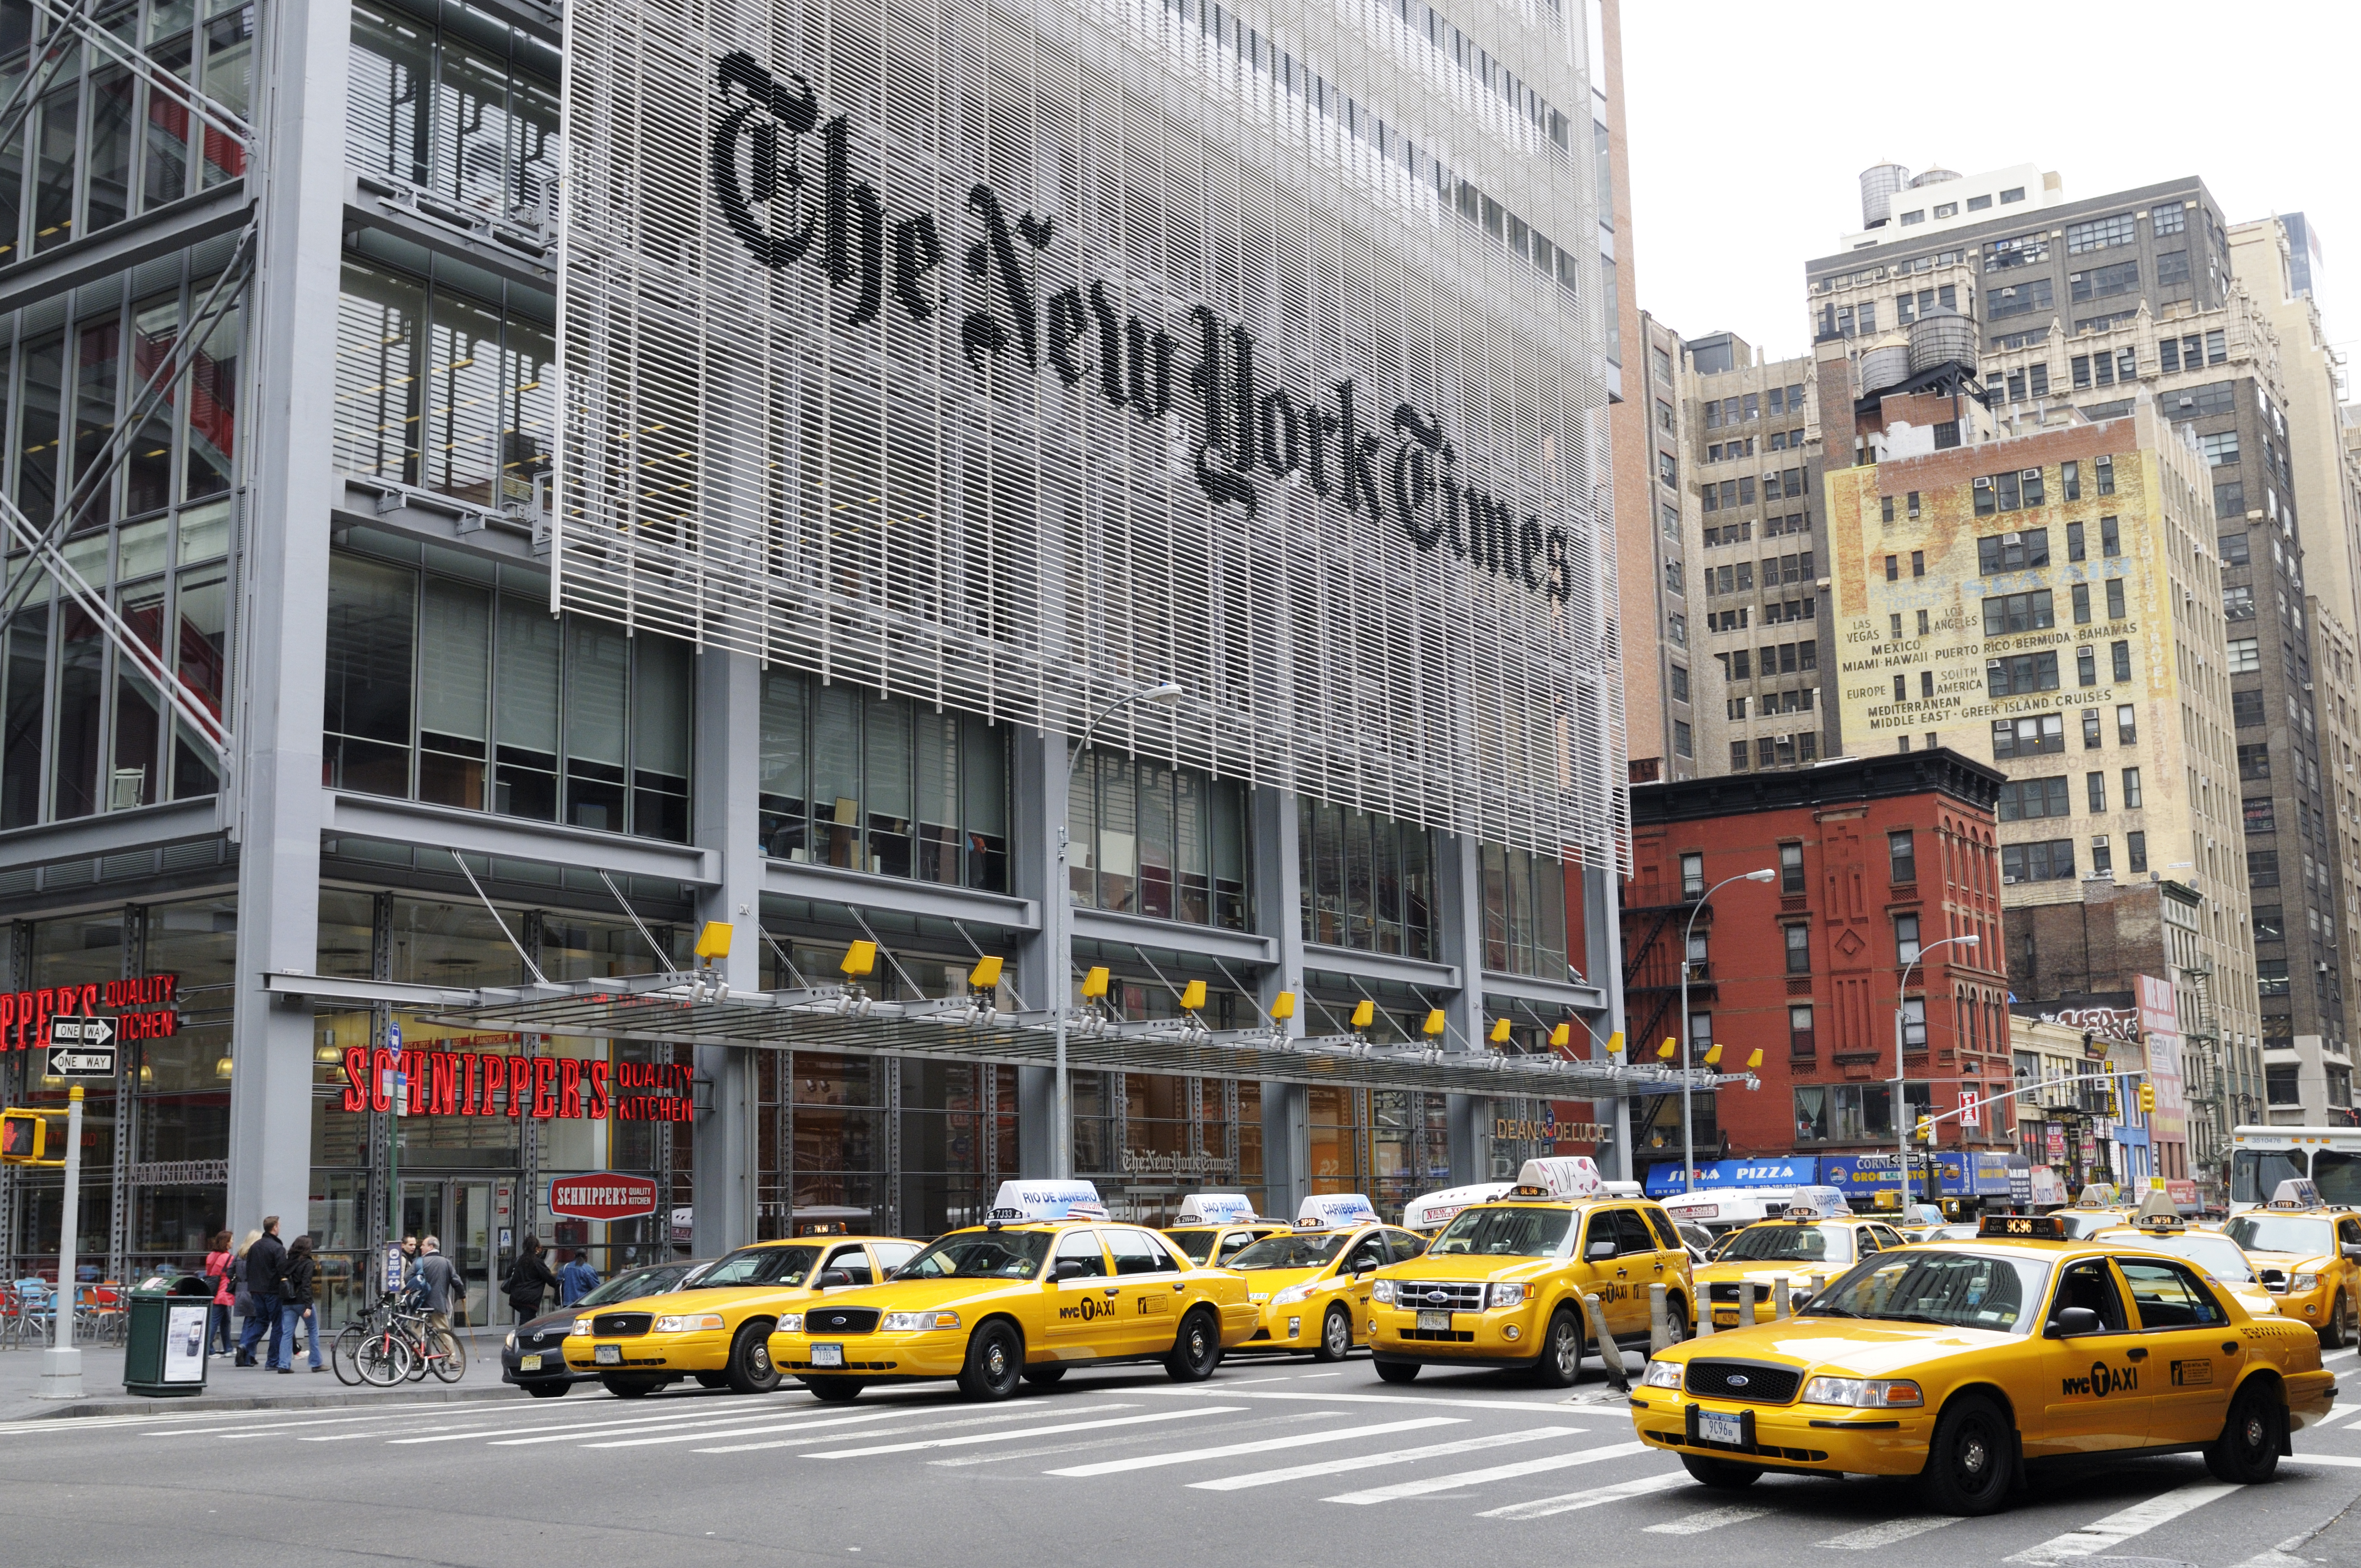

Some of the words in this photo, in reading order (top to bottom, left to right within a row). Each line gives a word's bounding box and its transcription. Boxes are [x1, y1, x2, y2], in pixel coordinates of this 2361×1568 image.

[712, 50, 946, 328] The
[961, 183, 1179, 421] New
[1190, 304, 1381, 520] York
[1392, 402, 1573, 605] Times
[1945, 606, 1964, 617] LOS
[1853, 619, 1871, 630] LAS
[1934, 616, 1978, 631] ANGELES
[1847, 630, 1879, 643] VEGAS
[1843, 658, 1879, 672] MIAMI
[1885, 652, 1927, 666] HAWAII
[1935, 645, 1978, 660] PUERTO
[1984, 640, 2010, 653] RICO
[2016, 633, 2071, 649] BERMUDA
[2079, 623, 2137, 640] BAHAMAS
[1872, 640, 1921, 655] MEXICO
[2148, 620, 2164, 688] TRAVEL
[1941, 667, 1977, 680] SOUTH
[1847, 685, 1886, 700] EUROPE
[1936, 679, 1983, 695] AMERICA
[1868, 696, 1961, 717] MEDITERRANEAN
[1870, 715, 1914, 729] MIDDLE
[1921, 710, 1951, 723] EAST
[1961, 705, 1999, 718] GREEK
[2005, 698, 2049, 713] ISLAND
[2055, 689, 2112, 706] CRUISES
[106, 974, 179, 1008] QUALITY
[2142, 975, 2157, 1010] WE
[2156, 978, 2172, 1012] BUY
[61, 1025, 79, 1036] ONE
[88, 1027, 107, 1037] WAY
[476, 1035, 506, 1045] SANDWICHES
[2150, 1037, 2168, 1057] GEM
[58, 1056, 77, 1067] ONE
[86, 1057, 107, 1068] WAY
[342, 1046, 610, 1120] SCHNIPPER'S
[617, 1061, 694, 1090] QUALITY
[616, 1095, 694, 1123] KITCHEN
[1497, 1119, 1537, 1140] DEAN
[1541, 1121, 1549, 1139] &
[1554, 1121, 1605, 1142] DELUCA
[1122, 1148, 1145, 1173] The
[1145, 1149, 1172, 1172] New
[1171, 1150, 1201, 1178] York
[1201, 1150, 1233, 1172] Times
[1736, 1166, 1794, 1179] PIZZA
[557, 1186, 627, 1206] SCHNIPPER'S
[629, 1186, 651, 1196] QUALITY
[1022, 1192, 1041, 1204] RIO
[1042, 1192, 1057, 1202] DE
[1058, 1191, 1097, 1202] JANEIRO
[1520, 1187, 1538, 1195] 8L96
[2037, 1188, 2052, 1202] SUITS
[629, 1196, 651, 1205] KITCHEN
[1074, 1201, 1101, 1210] American
[1220, 1202, 1245, 1212] PAULO
[996, 1210, 1012, 1219] 7J33
[1322, 1202, 1369, 1216] CARIBBEAN
[1427, 1203, 1446, 1220] NEW
[1301, 1218, 1315, 1227] 3P56
[2007, 1219, 2032, 1233] 9C96
[2151, 1216, 2171, 1224] 3V51
[502, 1231, 509, 1242] A
[1606, 1282, 1628, 1303] TAXI
[1060, 1306, 1080, 1319] NYC
[1081, 1298, 1115, 1320] TAXI
[2063, 1376, 2090, 1395] NYC
[2092, 1364, 2137, 1396] TAXI
[1709, 1420, 1733, 1436] 9C96B
